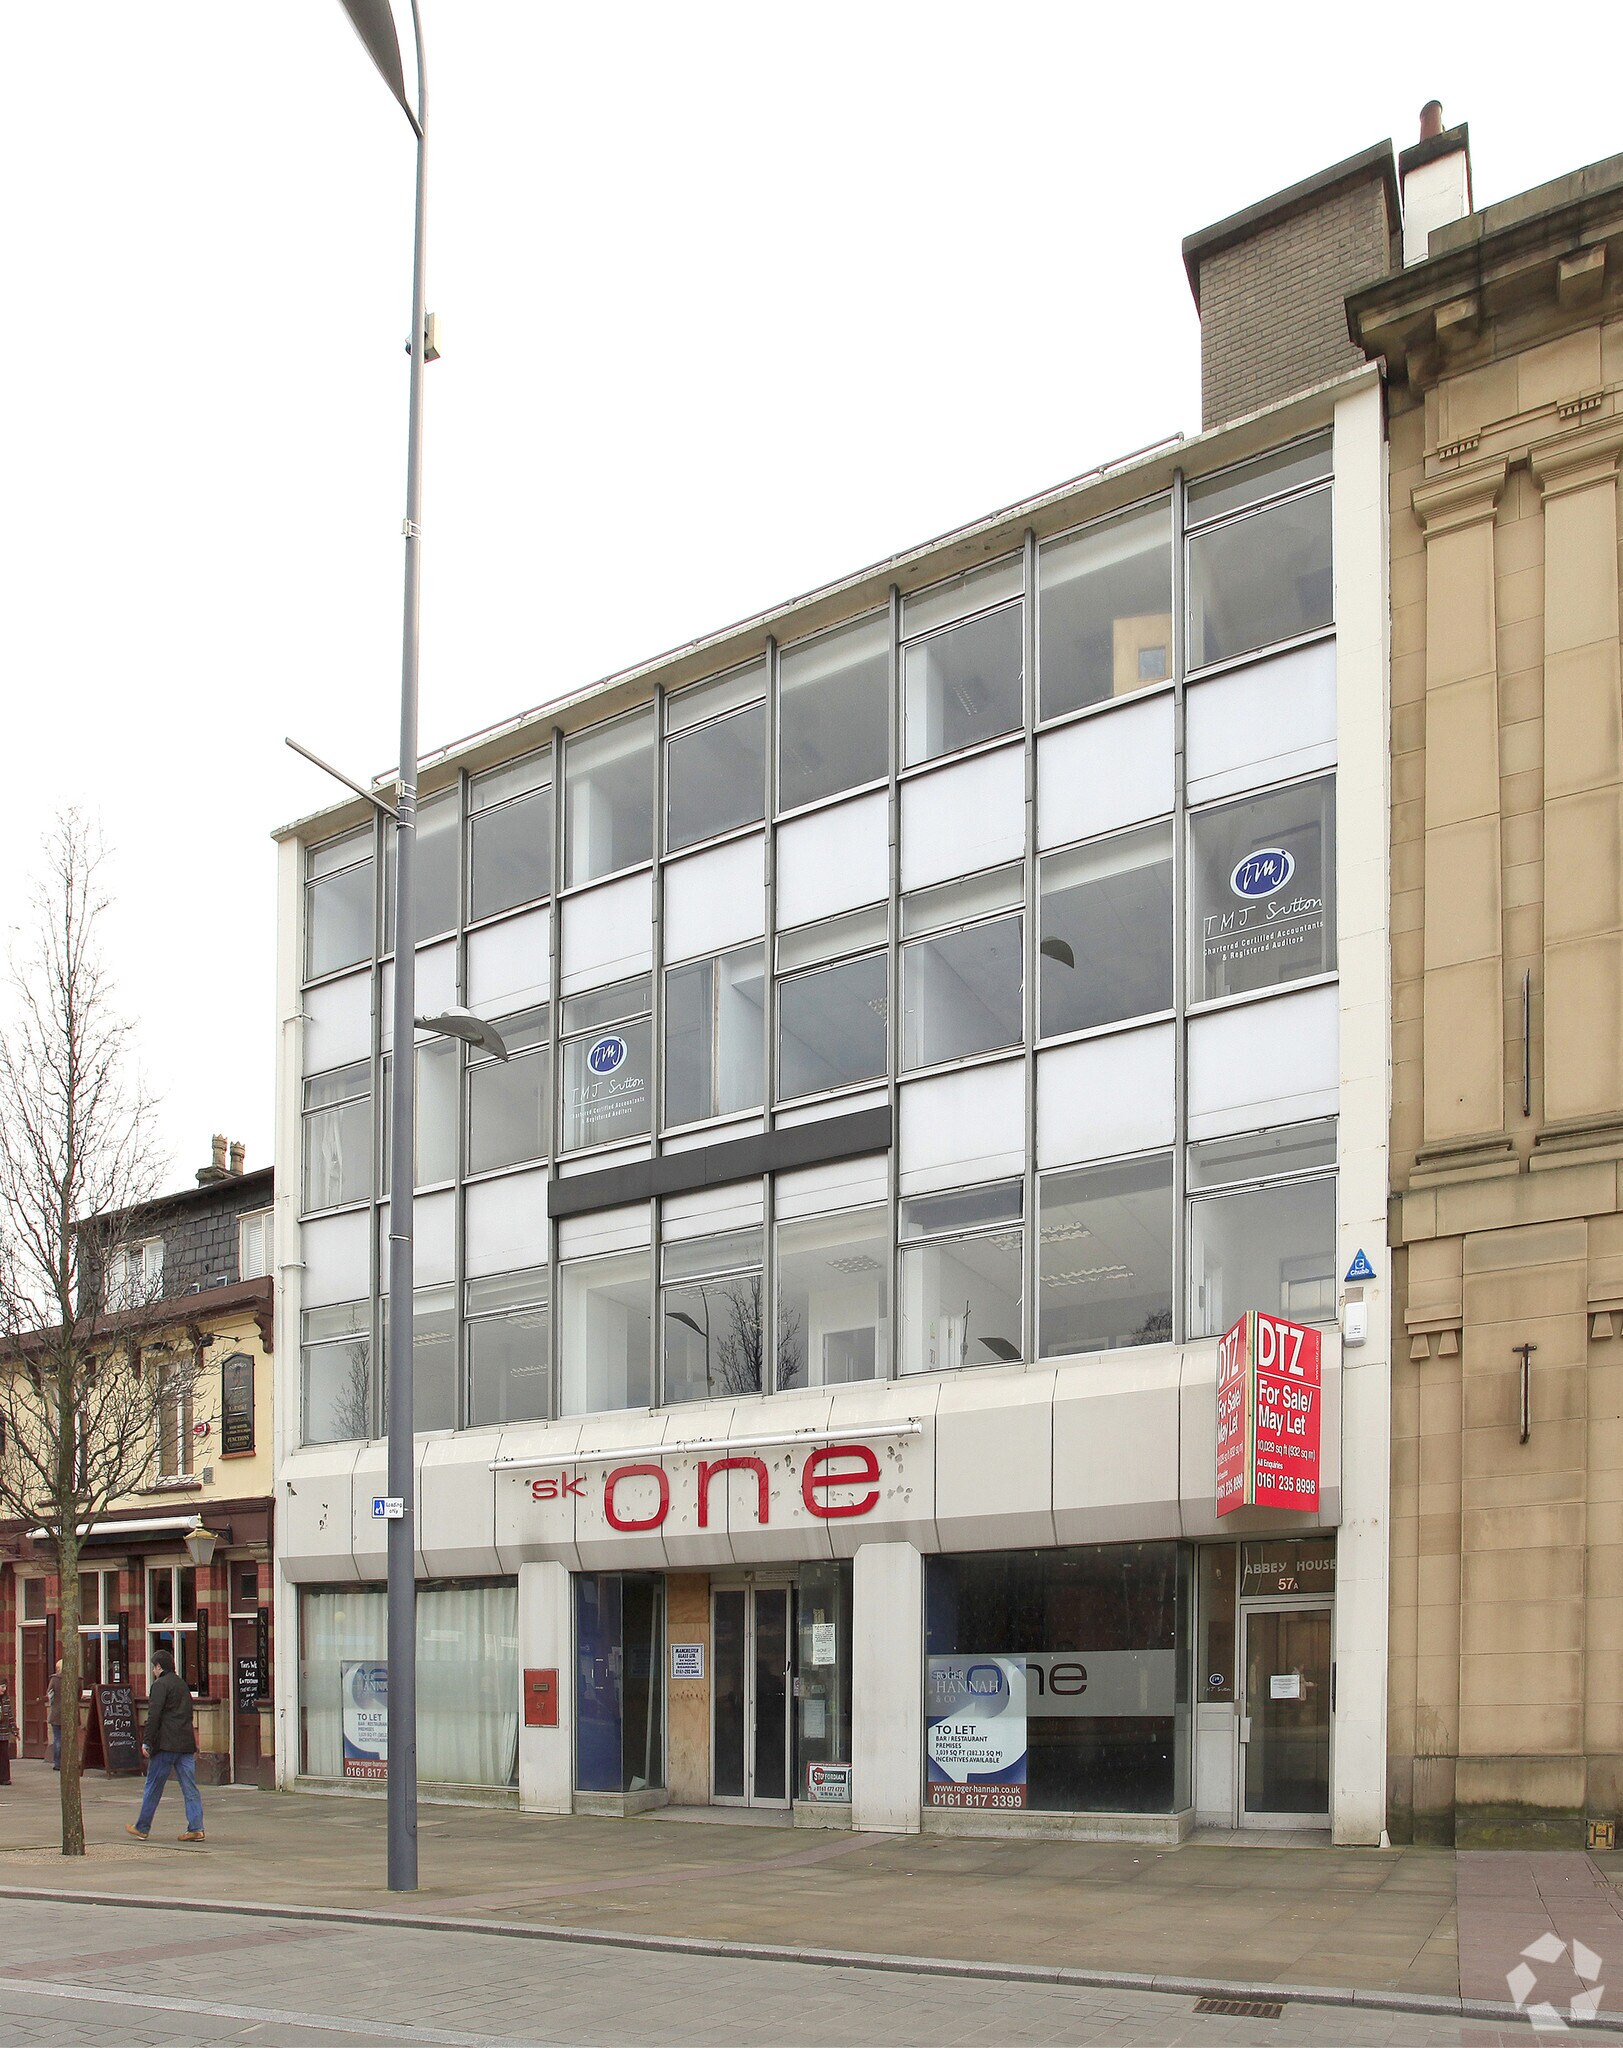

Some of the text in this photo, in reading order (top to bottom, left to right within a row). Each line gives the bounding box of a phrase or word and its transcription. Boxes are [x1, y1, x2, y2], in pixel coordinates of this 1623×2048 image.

[1242, 857, 1286, 890] TMJ
[1266, 897, 1322, 920] Sutton
[1203, 920, 1324, 956] Chartered Certified Accountants
[1222, 936, 1304, 961] & Registered Auditors
[608, 1077, 644, 1093] Sutton
[1350, 1268, 1370, 1276] Chubb
[1258, 1317, 1305, 1376] DTZ
[1218, 1325, 1240, 1389] DTZ
[1259, 1379, 1313, 1412] For Sale/
[1228, 1410, 1239, 1437] Let
[1258, 1404, 1306, 1436] May Let
[1257, 1439, 1275, 1453] 10,029
[1275, 1445, 1283, 1457] sq
[1283, 1443, 1288, 1455] ft
[1288, 1444, 1301, 1458] (932
[1301, 1449, 1308, 1461] sq
[1263, 1459, 1284, 1470] Enquiries
[1257, 1472, 1316, 1495] 0161 235 8998
[1246, 1560, 1336, 1574] ABBEY HOUSE
[936, 1671, 964, 1680] ROGER
[936, 1680, 999, 1693] HANNAH
[101, 1688, 132, 1705] CASK
[104, 1704, 132, 1718] ALES
[357, 1713, 382, 1721] TO LET
[936, 1725, 977, 1735] TO LET
[346, 1767, 365, 1776] 0161
[367, 1768, 382, 1777] 817
[934, 1784, 1020, 1795] www.roger-hannah.co.uk
[933, 1793, 1022, 1807] 0161 817 3399
